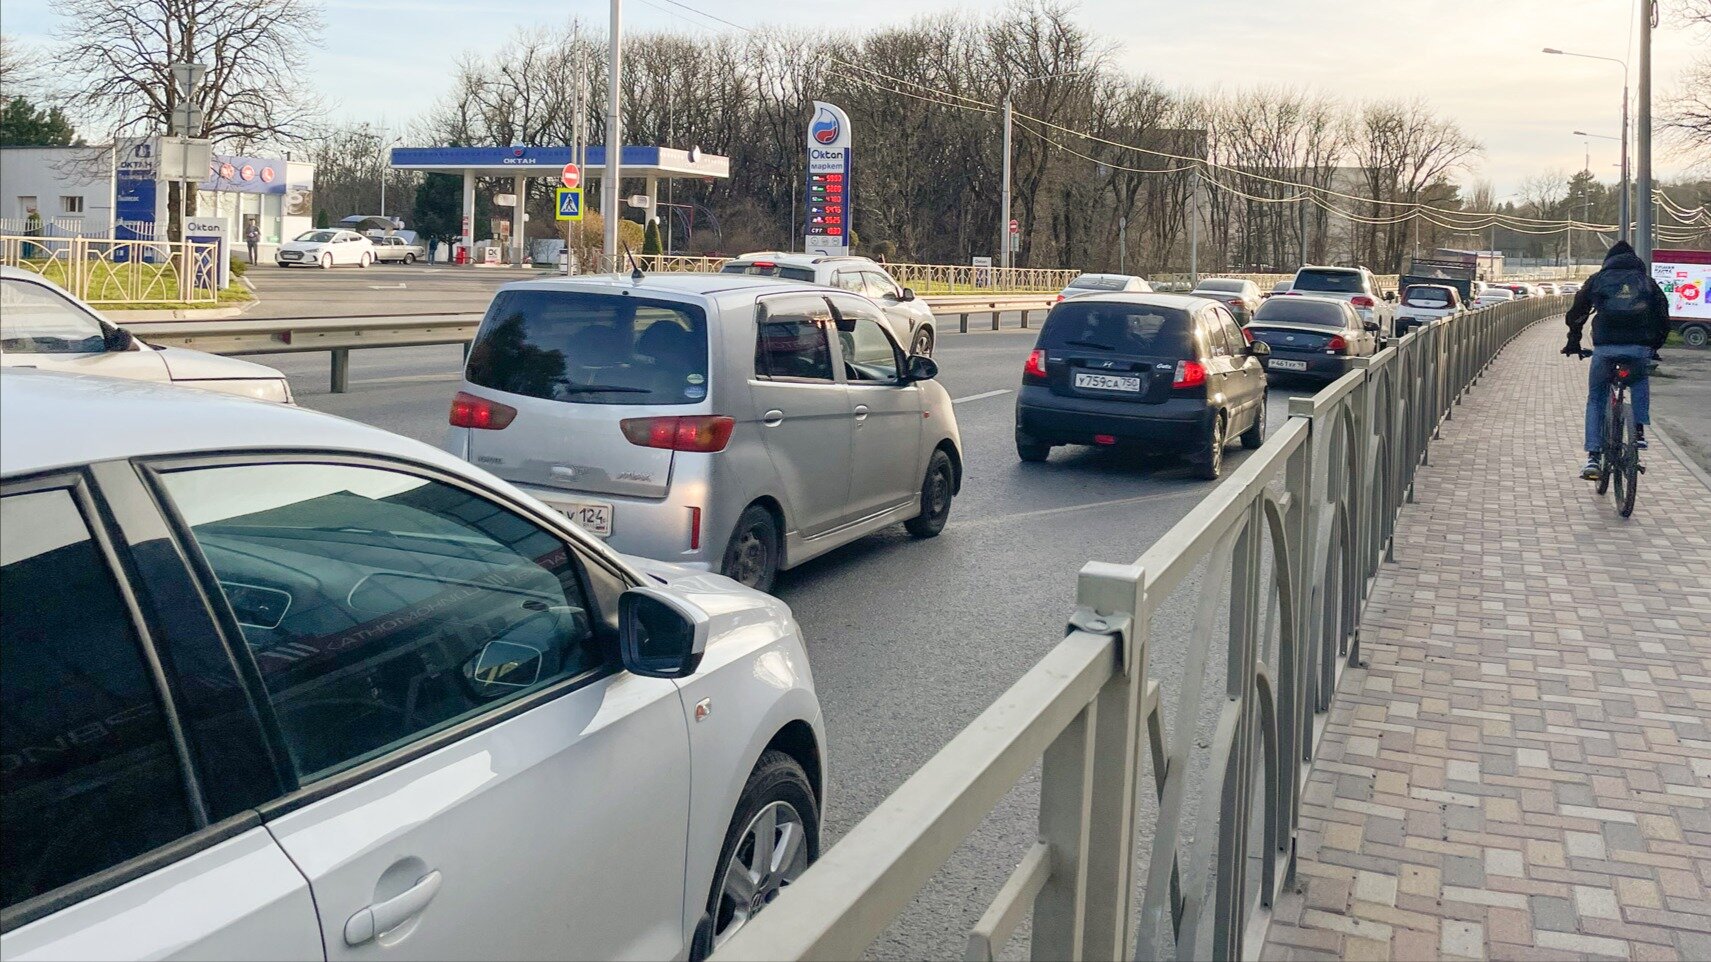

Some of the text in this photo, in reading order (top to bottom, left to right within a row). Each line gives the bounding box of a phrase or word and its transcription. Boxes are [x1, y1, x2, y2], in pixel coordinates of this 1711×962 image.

[811, 149, 843, 160] Oktan
[188, 222, 220, 231] Oktan
[579, 507, 603, 524] 124
